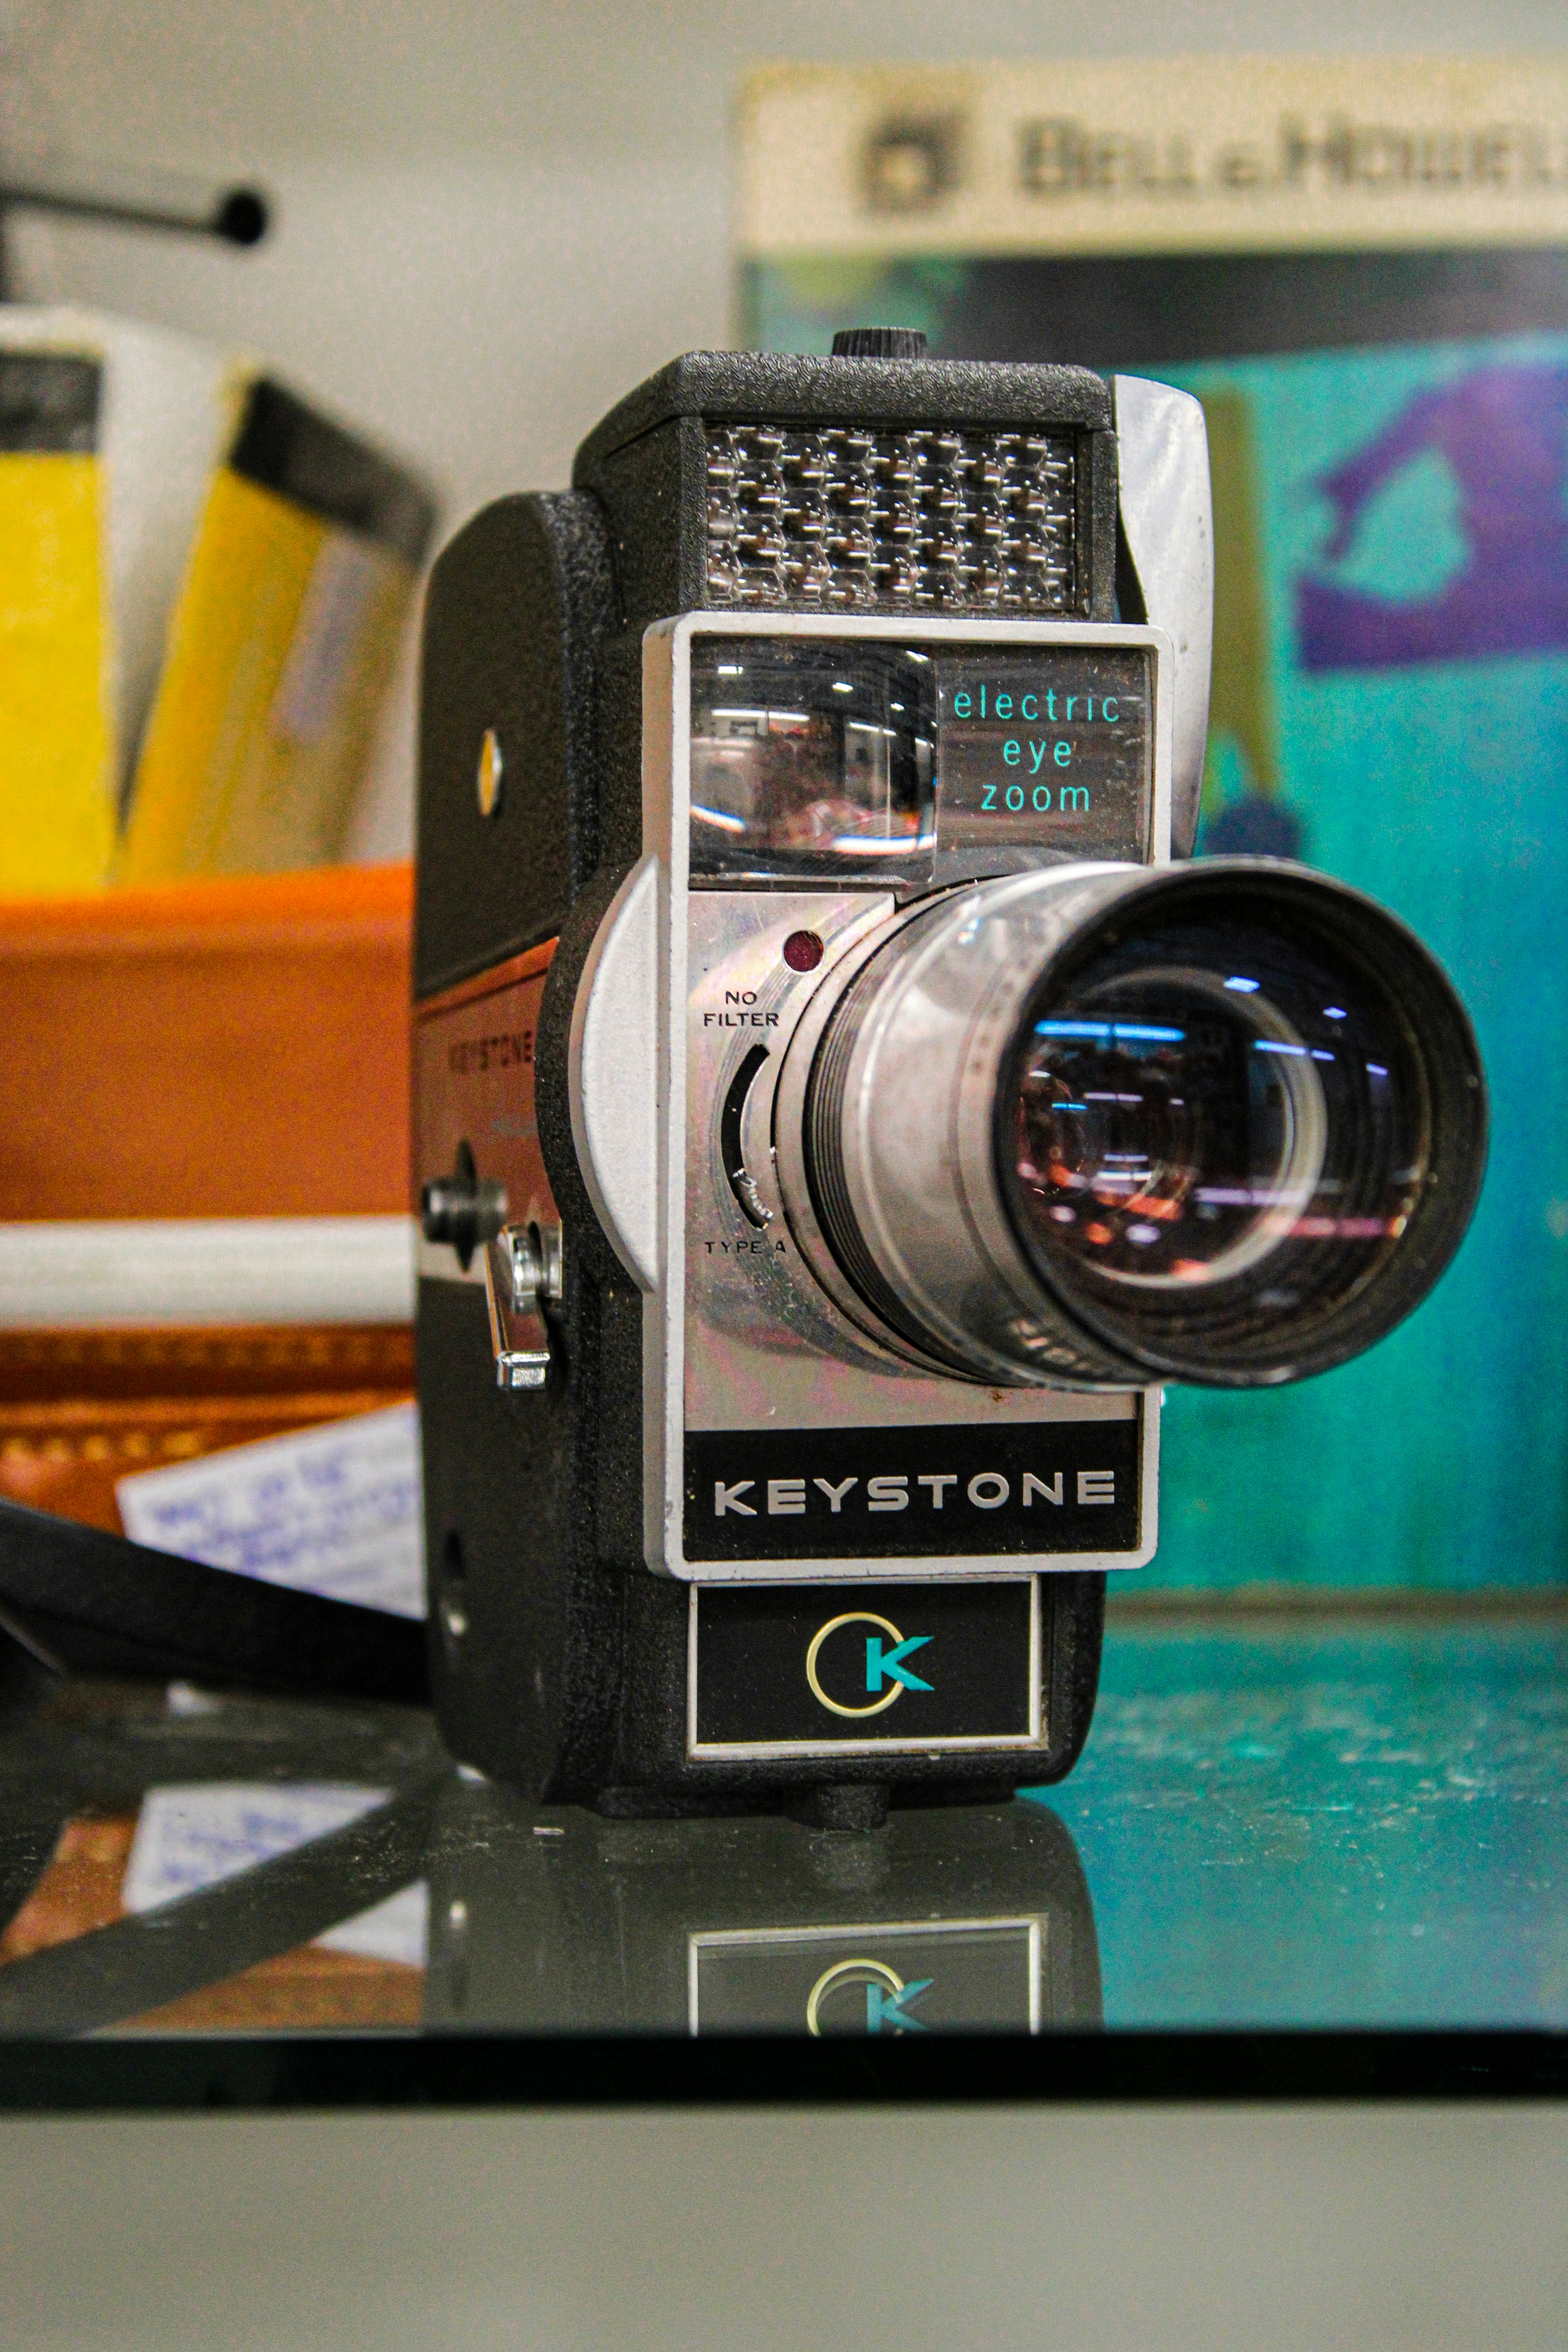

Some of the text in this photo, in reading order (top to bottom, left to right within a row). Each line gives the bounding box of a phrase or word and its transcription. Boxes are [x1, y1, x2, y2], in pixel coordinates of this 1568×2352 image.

[953, 684, 1120, 722] electric
[1003, 739, 1072, 774] eye
[981, 784, 1090, 812] zoom
[725, 991, 758, 1005] NO
[703, 1012, 779, 1027] FILTER
[704, 1240, 786, 1254] TYPE A
[713, 1470, 1115, 1517] KEYSTONE
